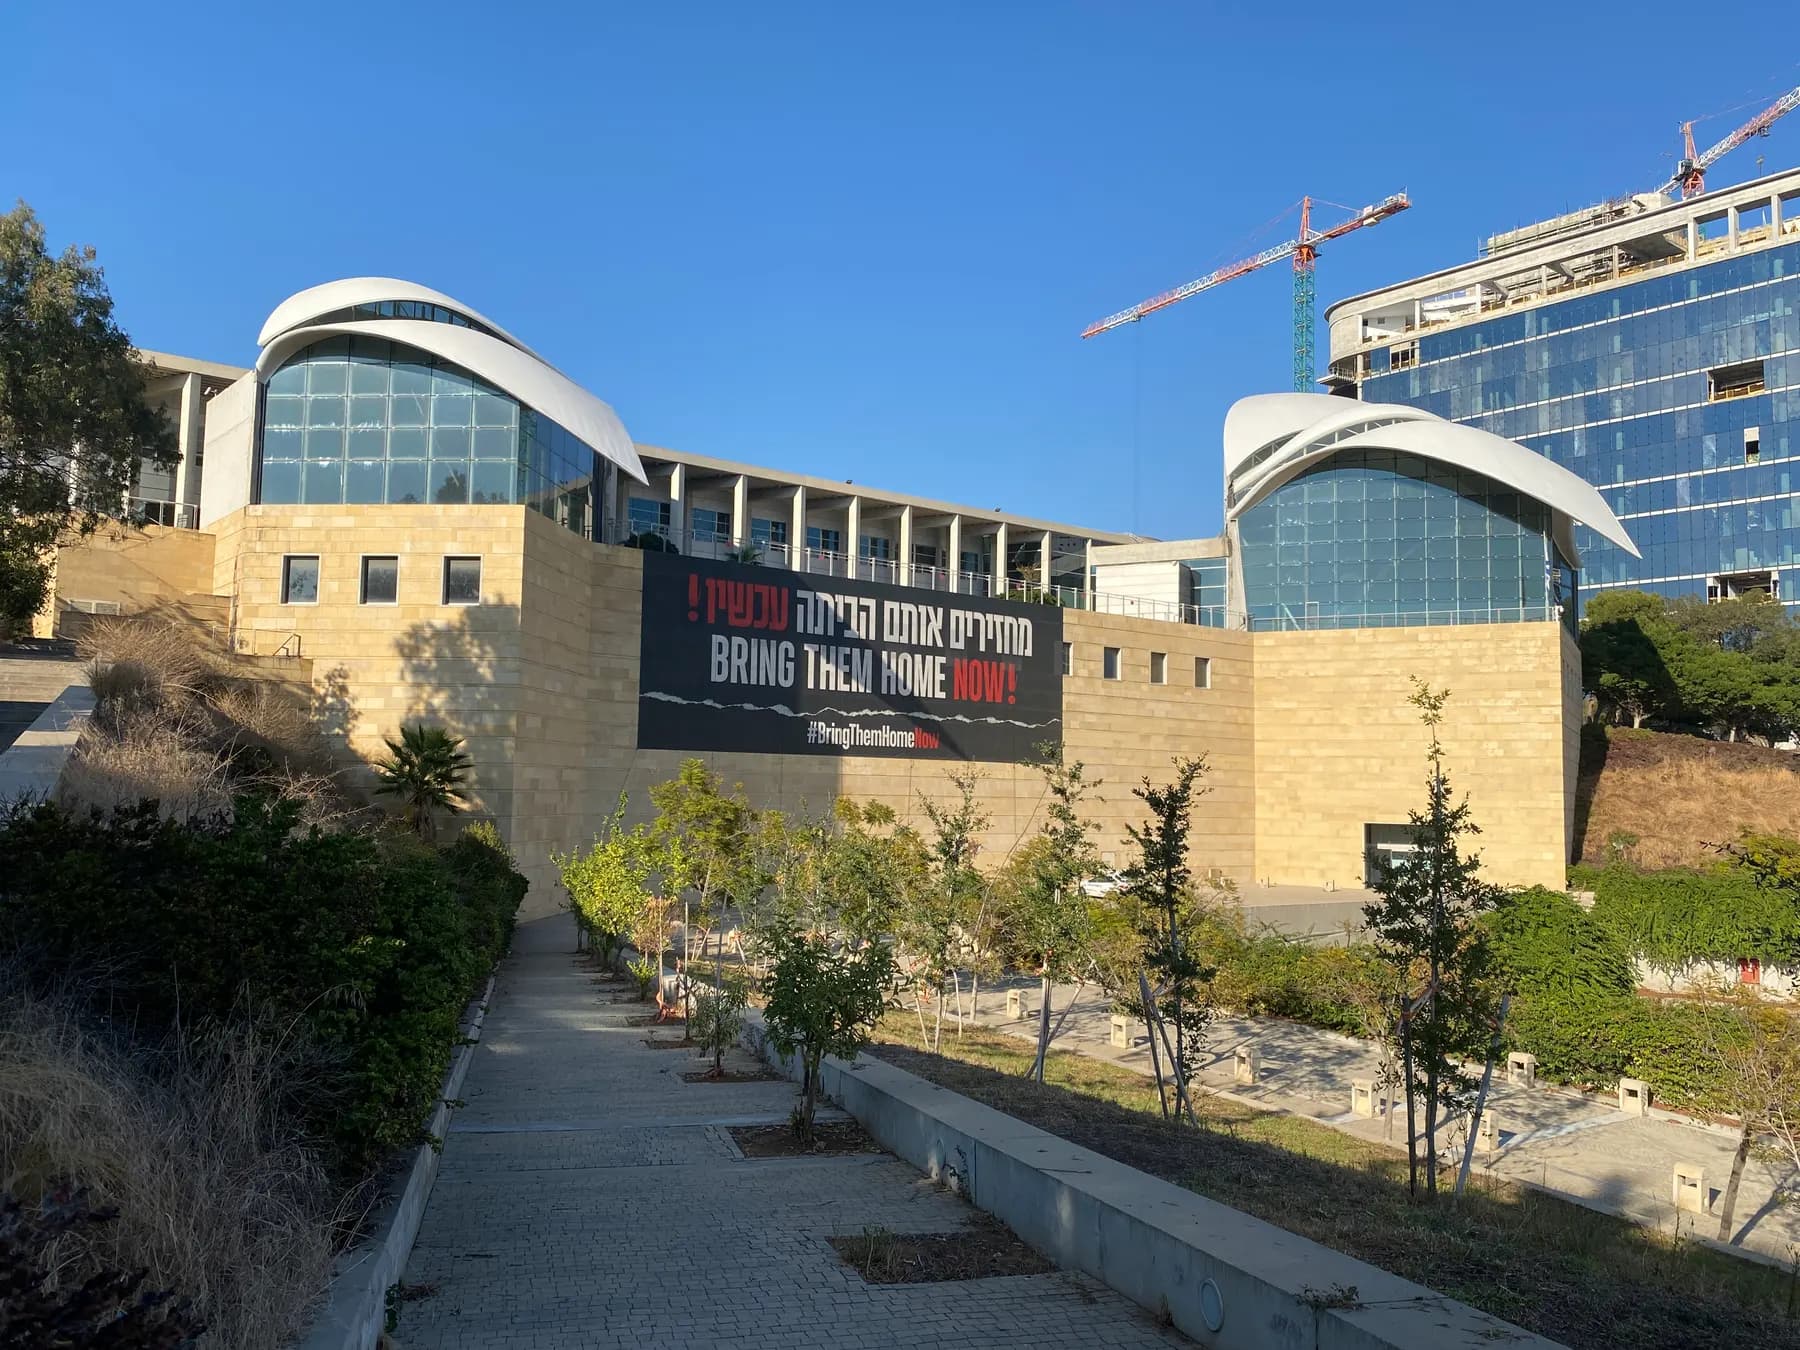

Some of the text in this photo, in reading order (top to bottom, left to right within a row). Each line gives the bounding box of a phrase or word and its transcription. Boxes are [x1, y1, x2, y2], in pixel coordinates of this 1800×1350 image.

[687, 573, 1033, 657] מחזירים אותם הביתה עכשיו!
[710, 634, 1017, 705] BRING THEM HOME NOW!
[807, 721, 940, 750] #BringThemHomeNow
